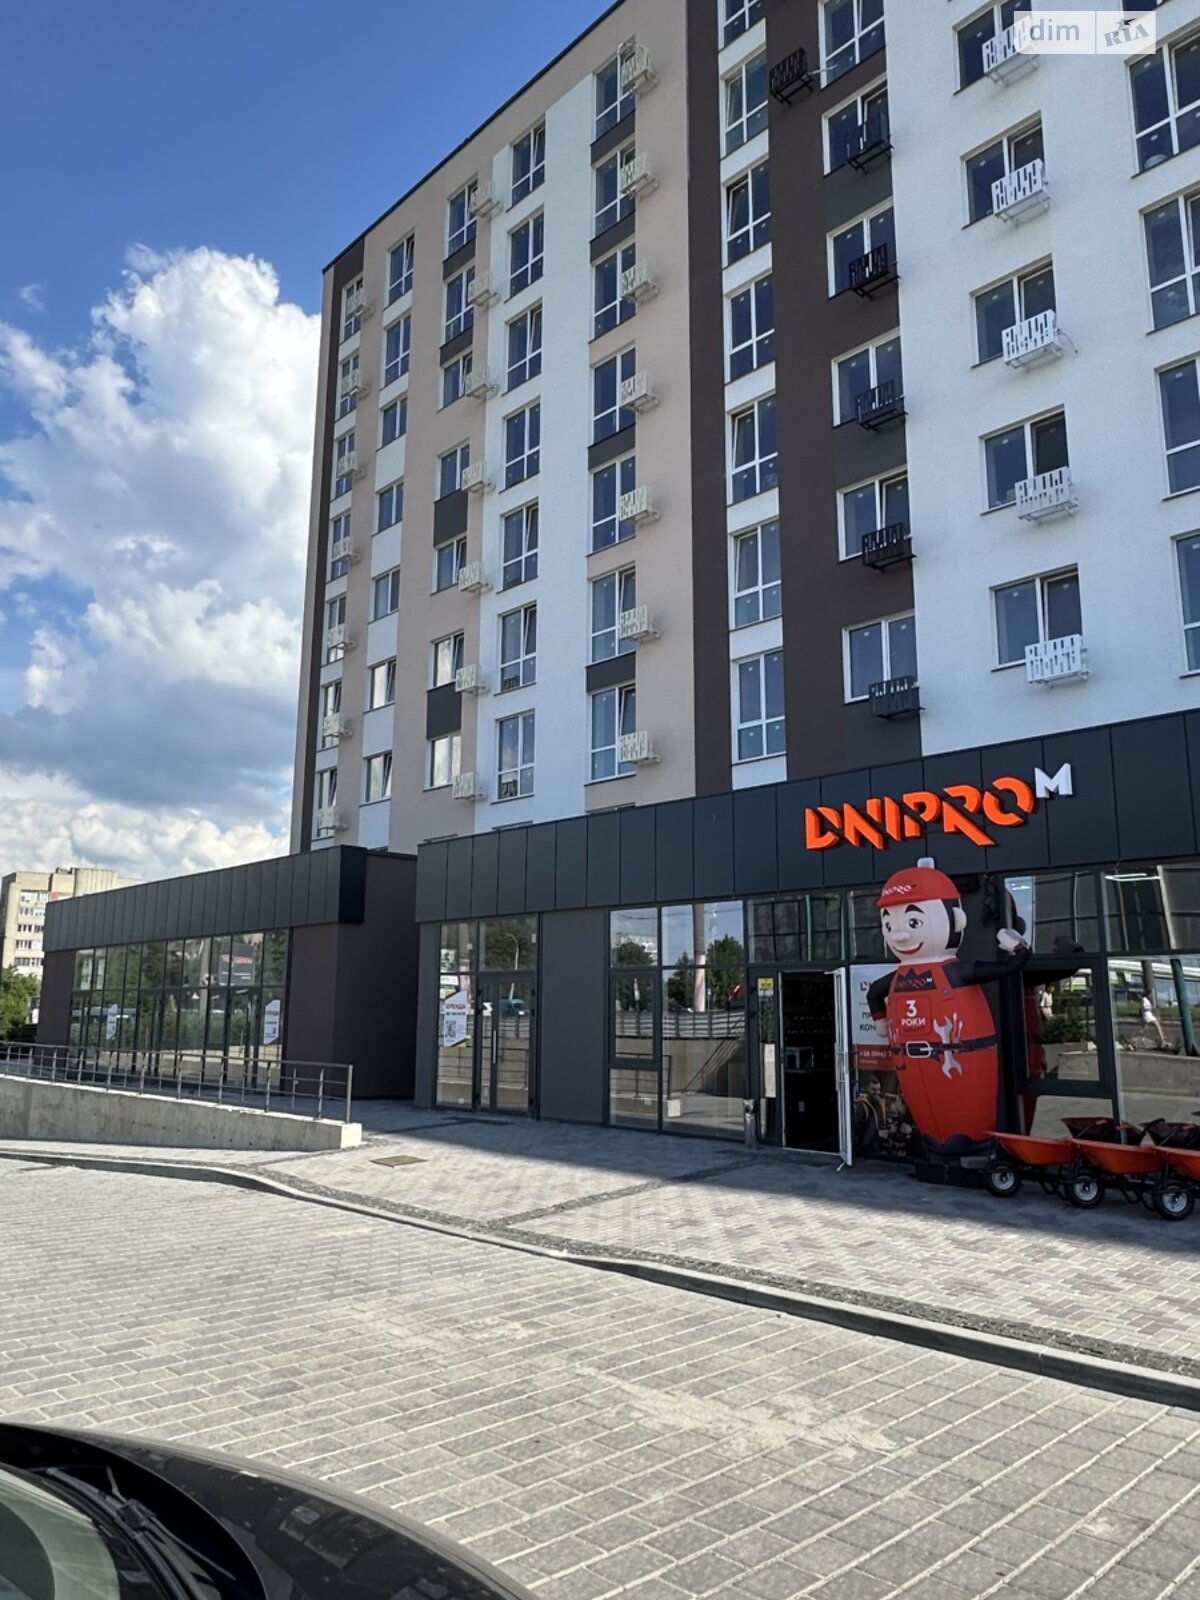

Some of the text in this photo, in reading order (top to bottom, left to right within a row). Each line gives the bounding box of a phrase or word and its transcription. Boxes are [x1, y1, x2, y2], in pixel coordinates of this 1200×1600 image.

[805, 777, 1034, 850] DNIPRO
[906, 1000, 917, 1017] 3
[901, 1018, 926, 1028] РОКИ
